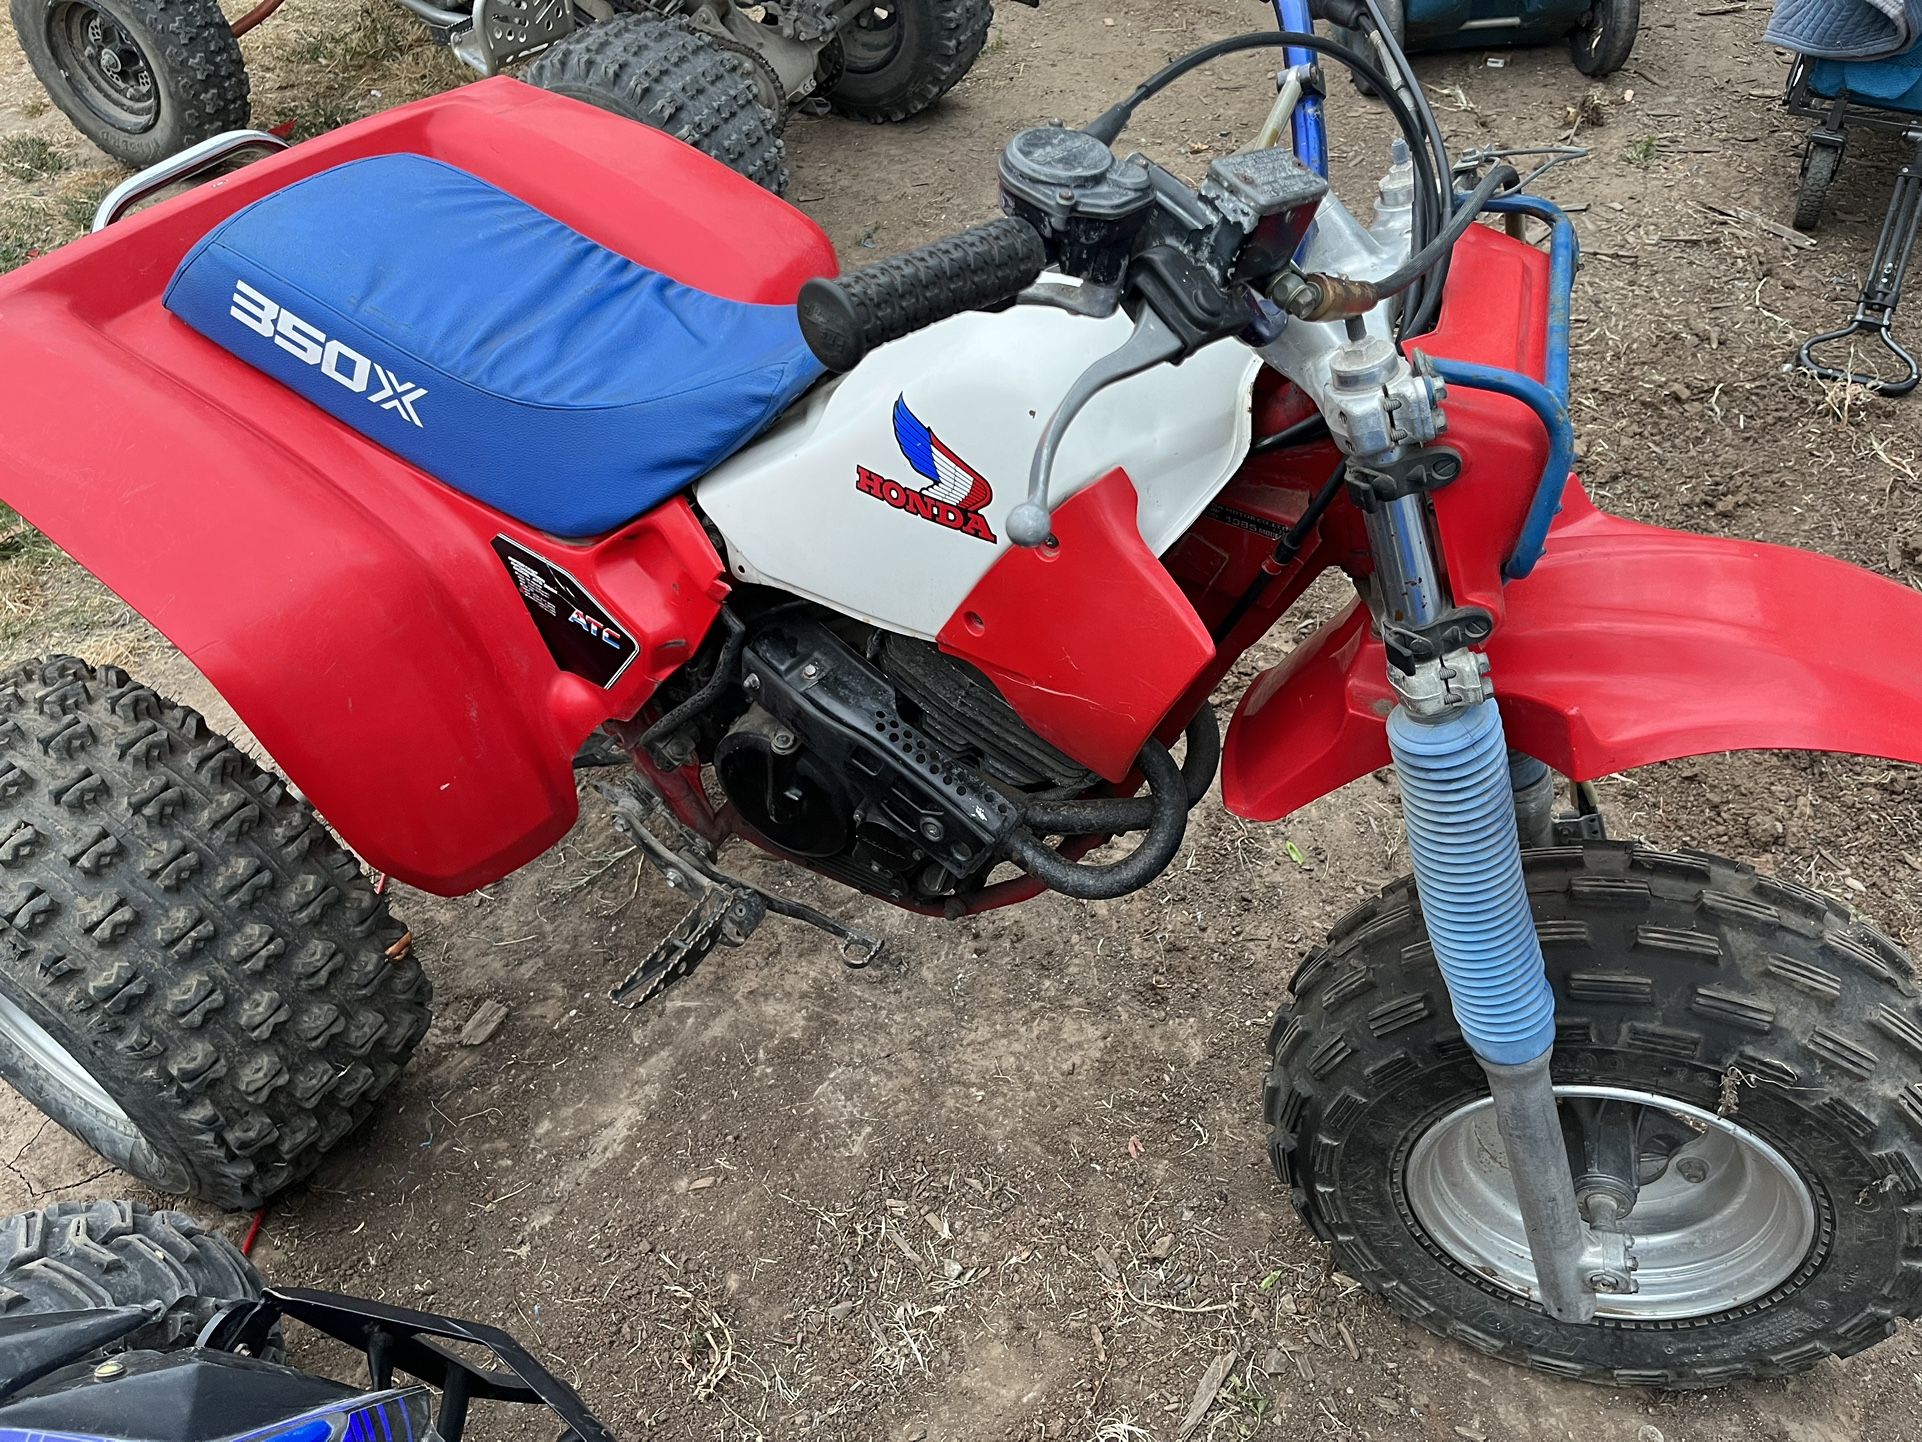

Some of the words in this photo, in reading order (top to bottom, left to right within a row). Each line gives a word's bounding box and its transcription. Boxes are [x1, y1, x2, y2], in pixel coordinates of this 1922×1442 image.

[230, 280, 428, 428] 350X
[856, 464, 997, 544] HONDA
[1226, 515, 1257, 532] 1985
[568, 609, 621, 649] ATC
